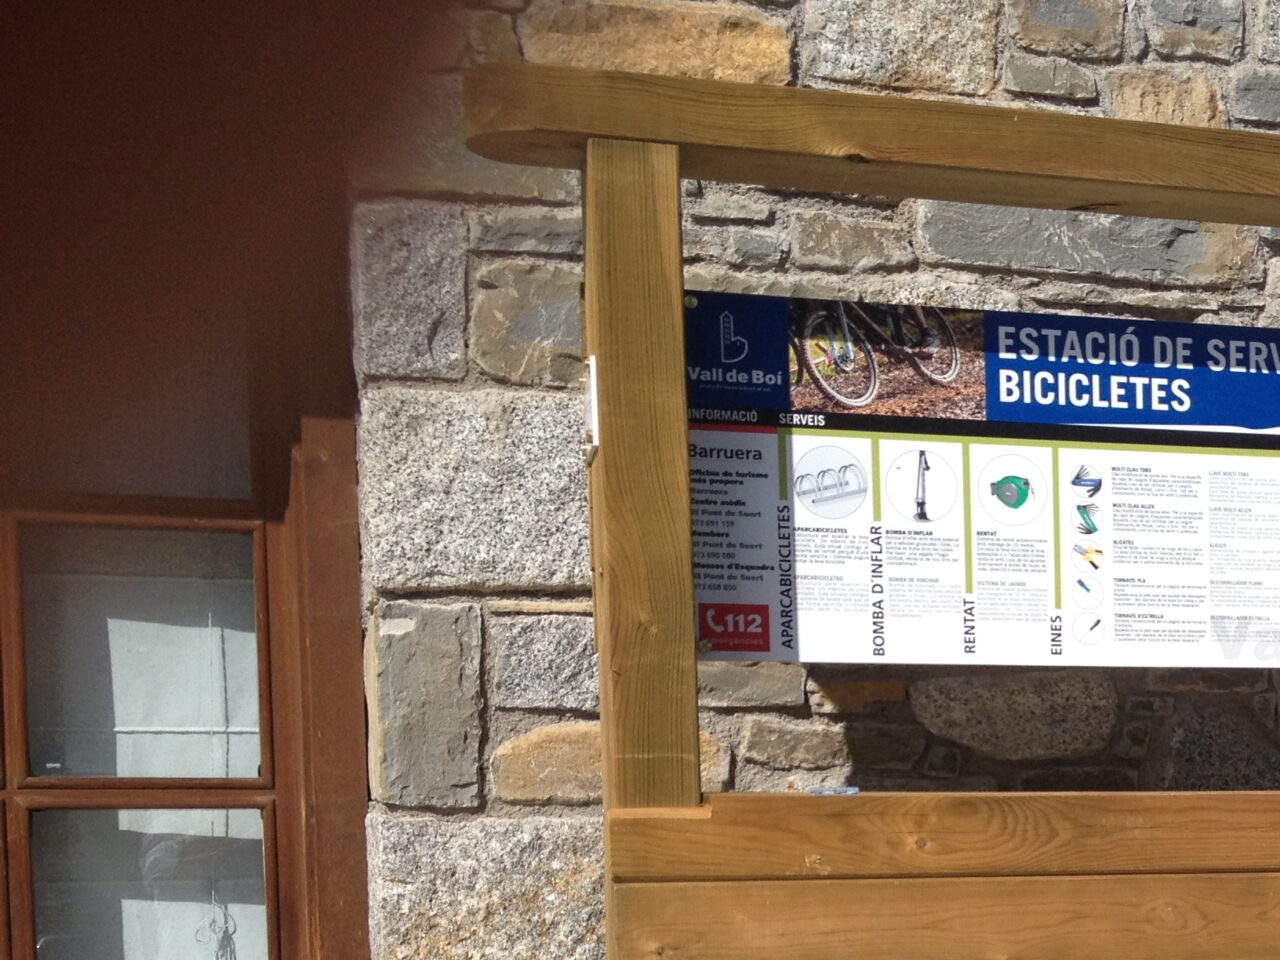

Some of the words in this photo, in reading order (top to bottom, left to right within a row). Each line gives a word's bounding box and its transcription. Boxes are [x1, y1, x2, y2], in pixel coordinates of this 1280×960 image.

[998, 326, 1140, 368] ESTACIÓ
[1154, 335, 1194, 370] DE
[687, 366, 723, 382] Vall
[725, 368, 749, 383] de
[752, 370, 783, 385] Boí
[998, 370, 1192, 412] BICICLETES
[688, 407, 758, 422] INFORMACIÓ
[778, 412, 825, 426] SERVEIS
[688, 443, 762, 461] Barruera
[777, 504, 794, 650] APARCABICICLETES
[724, 614, 763, 633] 112
[872, 599, 885, 656] BOMBA
[963, 597, 976, 654] RENTAT
[1050, 614, 1063, 655] EINES
